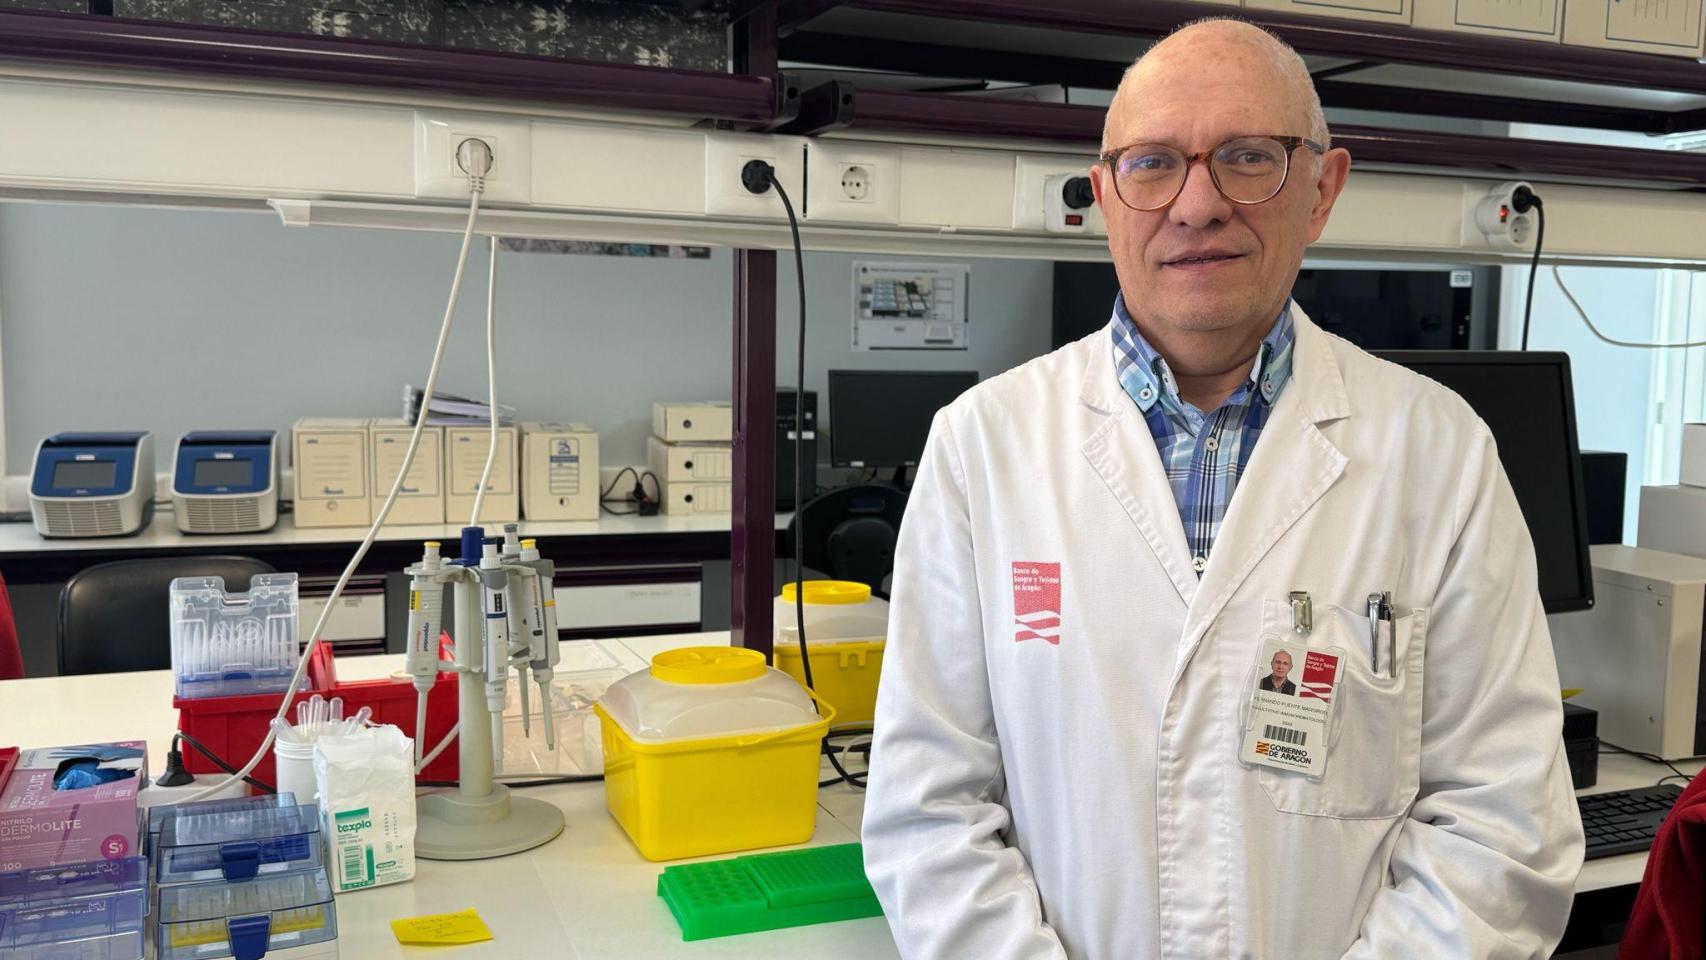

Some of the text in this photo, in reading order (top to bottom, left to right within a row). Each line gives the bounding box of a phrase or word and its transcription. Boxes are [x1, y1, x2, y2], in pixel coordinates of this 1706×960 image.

[1268, 750, 1279, 758] DE
[1269, 743, 1308, 757] GOBIERNO
[0, 819, 81, 836] DERMOLITE
[3, 862, 22, 871] 100
